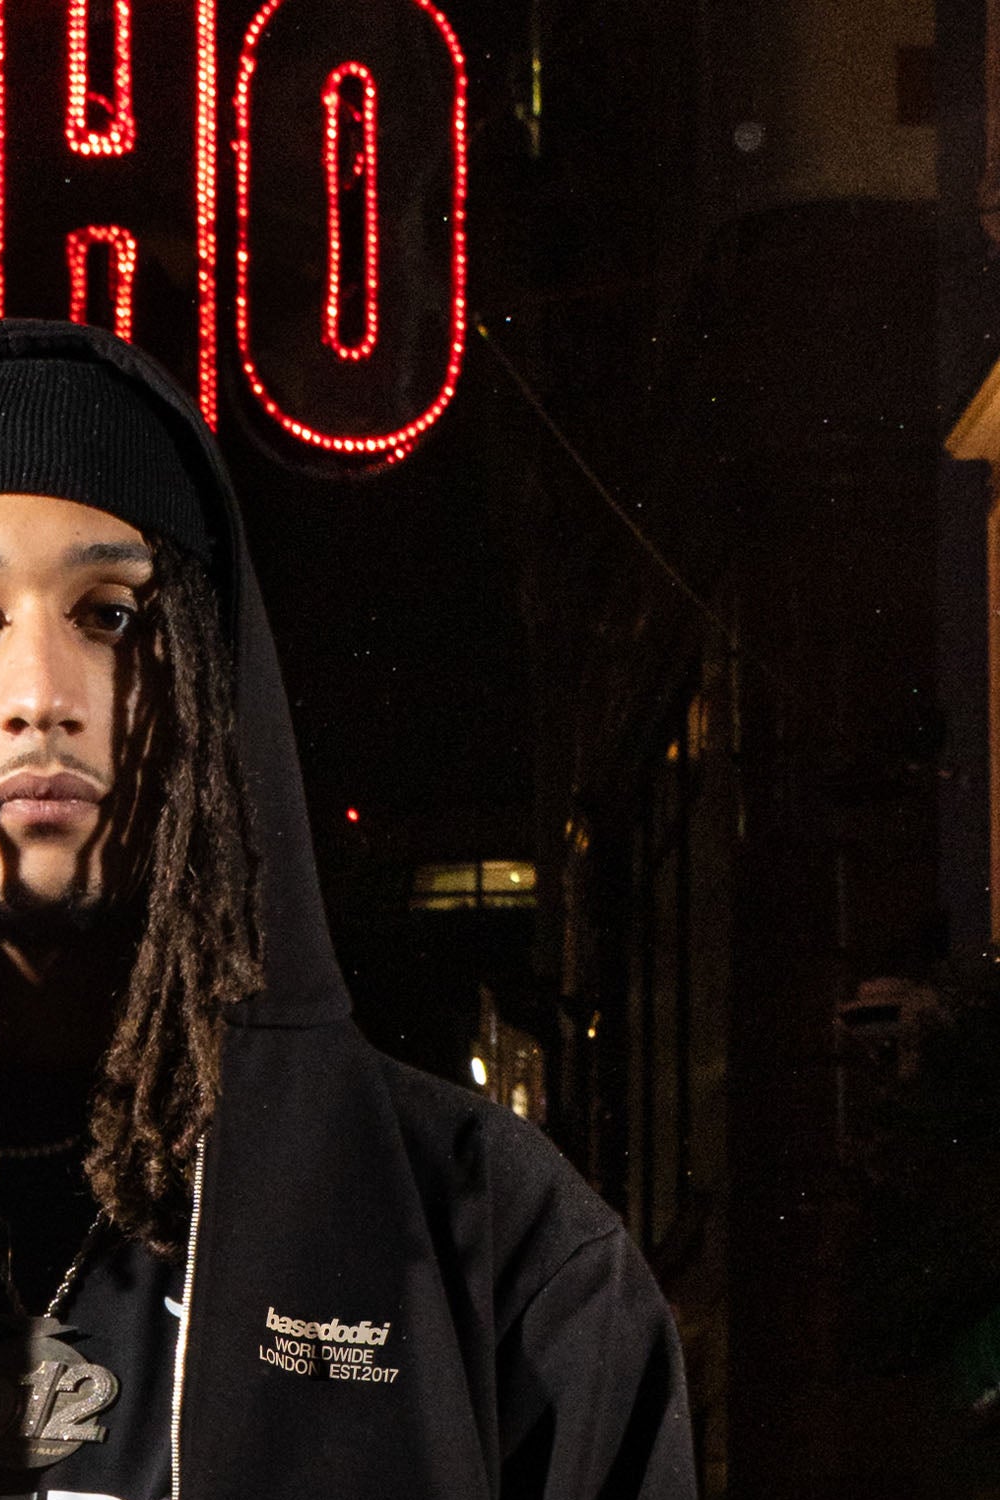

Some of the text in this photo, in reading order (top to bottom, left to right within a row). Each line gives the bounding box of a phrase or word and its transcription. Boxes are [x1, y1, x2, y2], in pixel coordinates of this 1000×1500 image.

[266, 1306, 391, 1345] basedodici
[275, 1336, 375, 1365] WORLDWIDE
[329, 1363, 399, 1384] EST.2017
